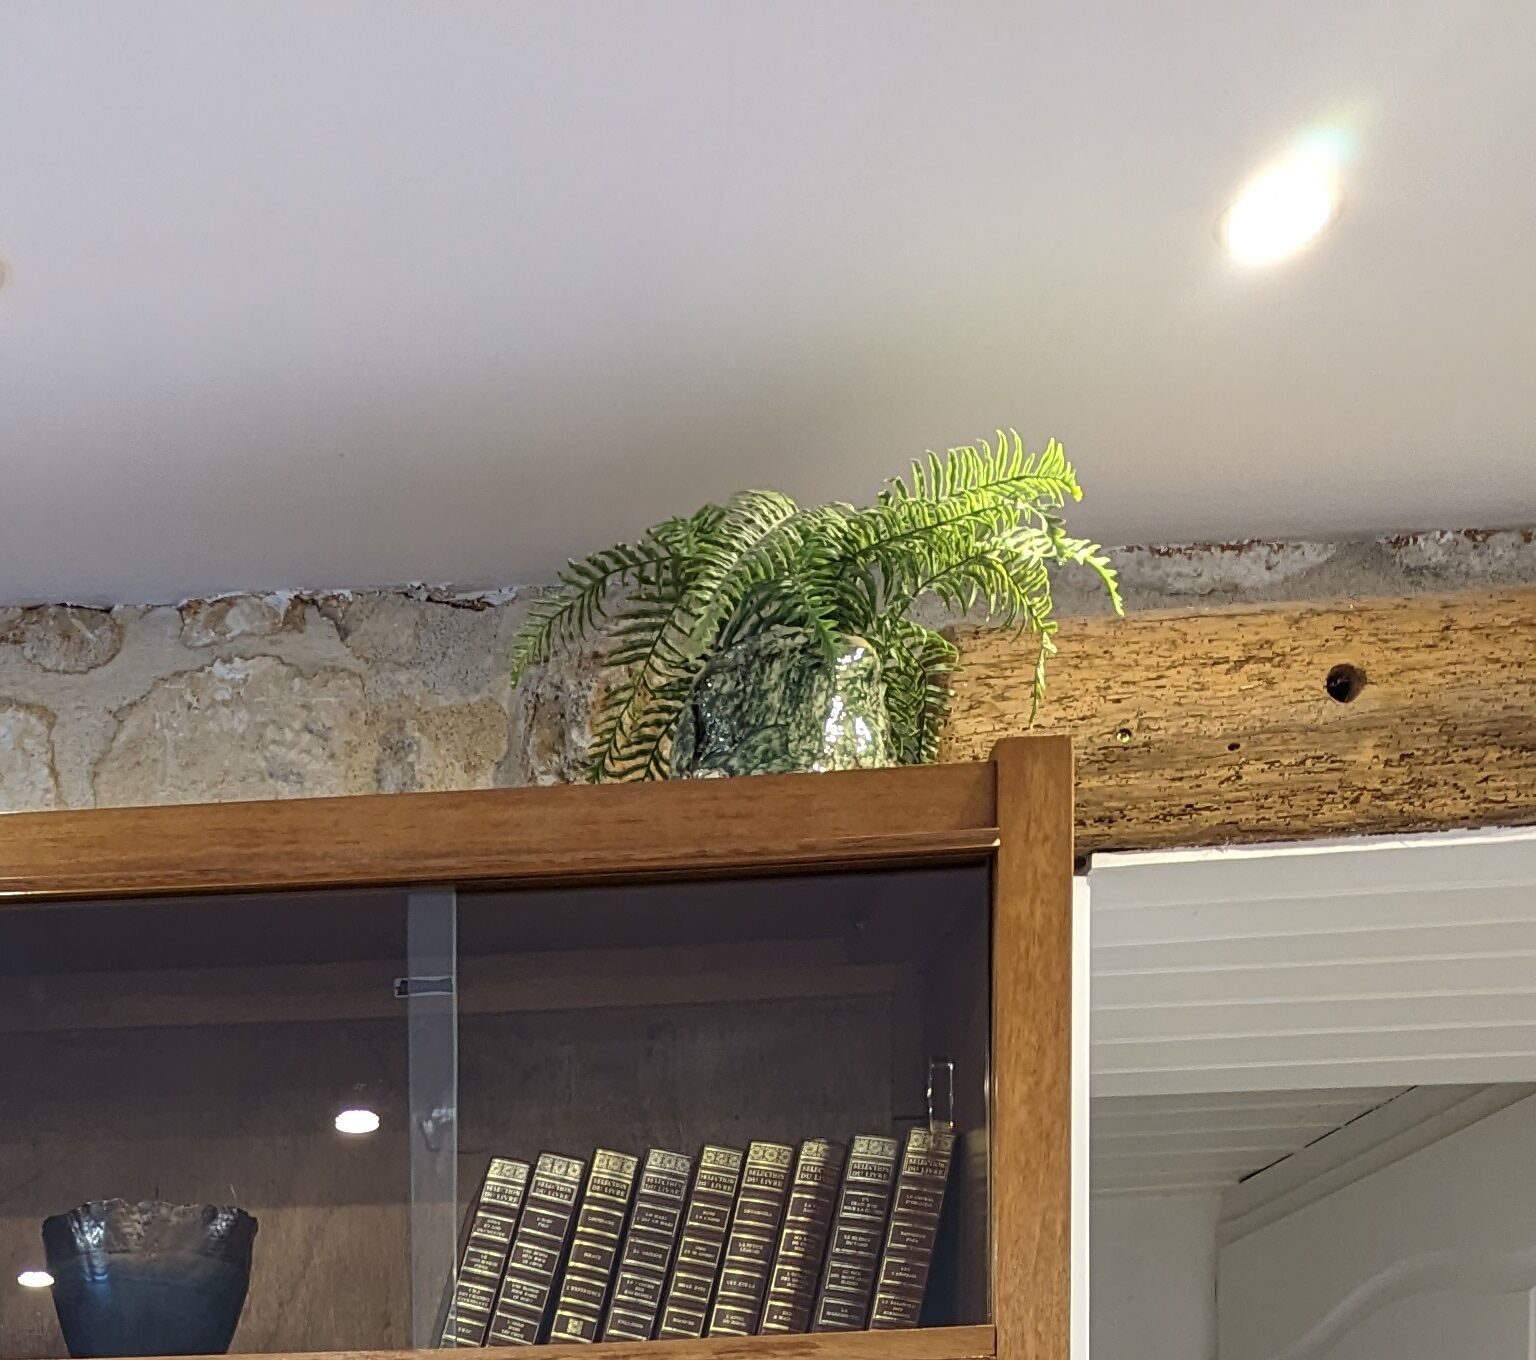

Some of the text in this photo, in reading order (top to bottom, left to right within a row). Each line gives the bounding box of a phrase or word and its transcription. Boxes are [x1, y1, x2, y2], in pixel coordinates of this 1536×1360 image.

[853, 1162, 889, 1173] SELECTION
[700, 1174, 735, 1184] SELECTION
[748, 1168, 785, 1180] SELECTION
[594, 1178, 628, 1190] SELECTION
[760, 1177, 784, 1188] LIVRE
